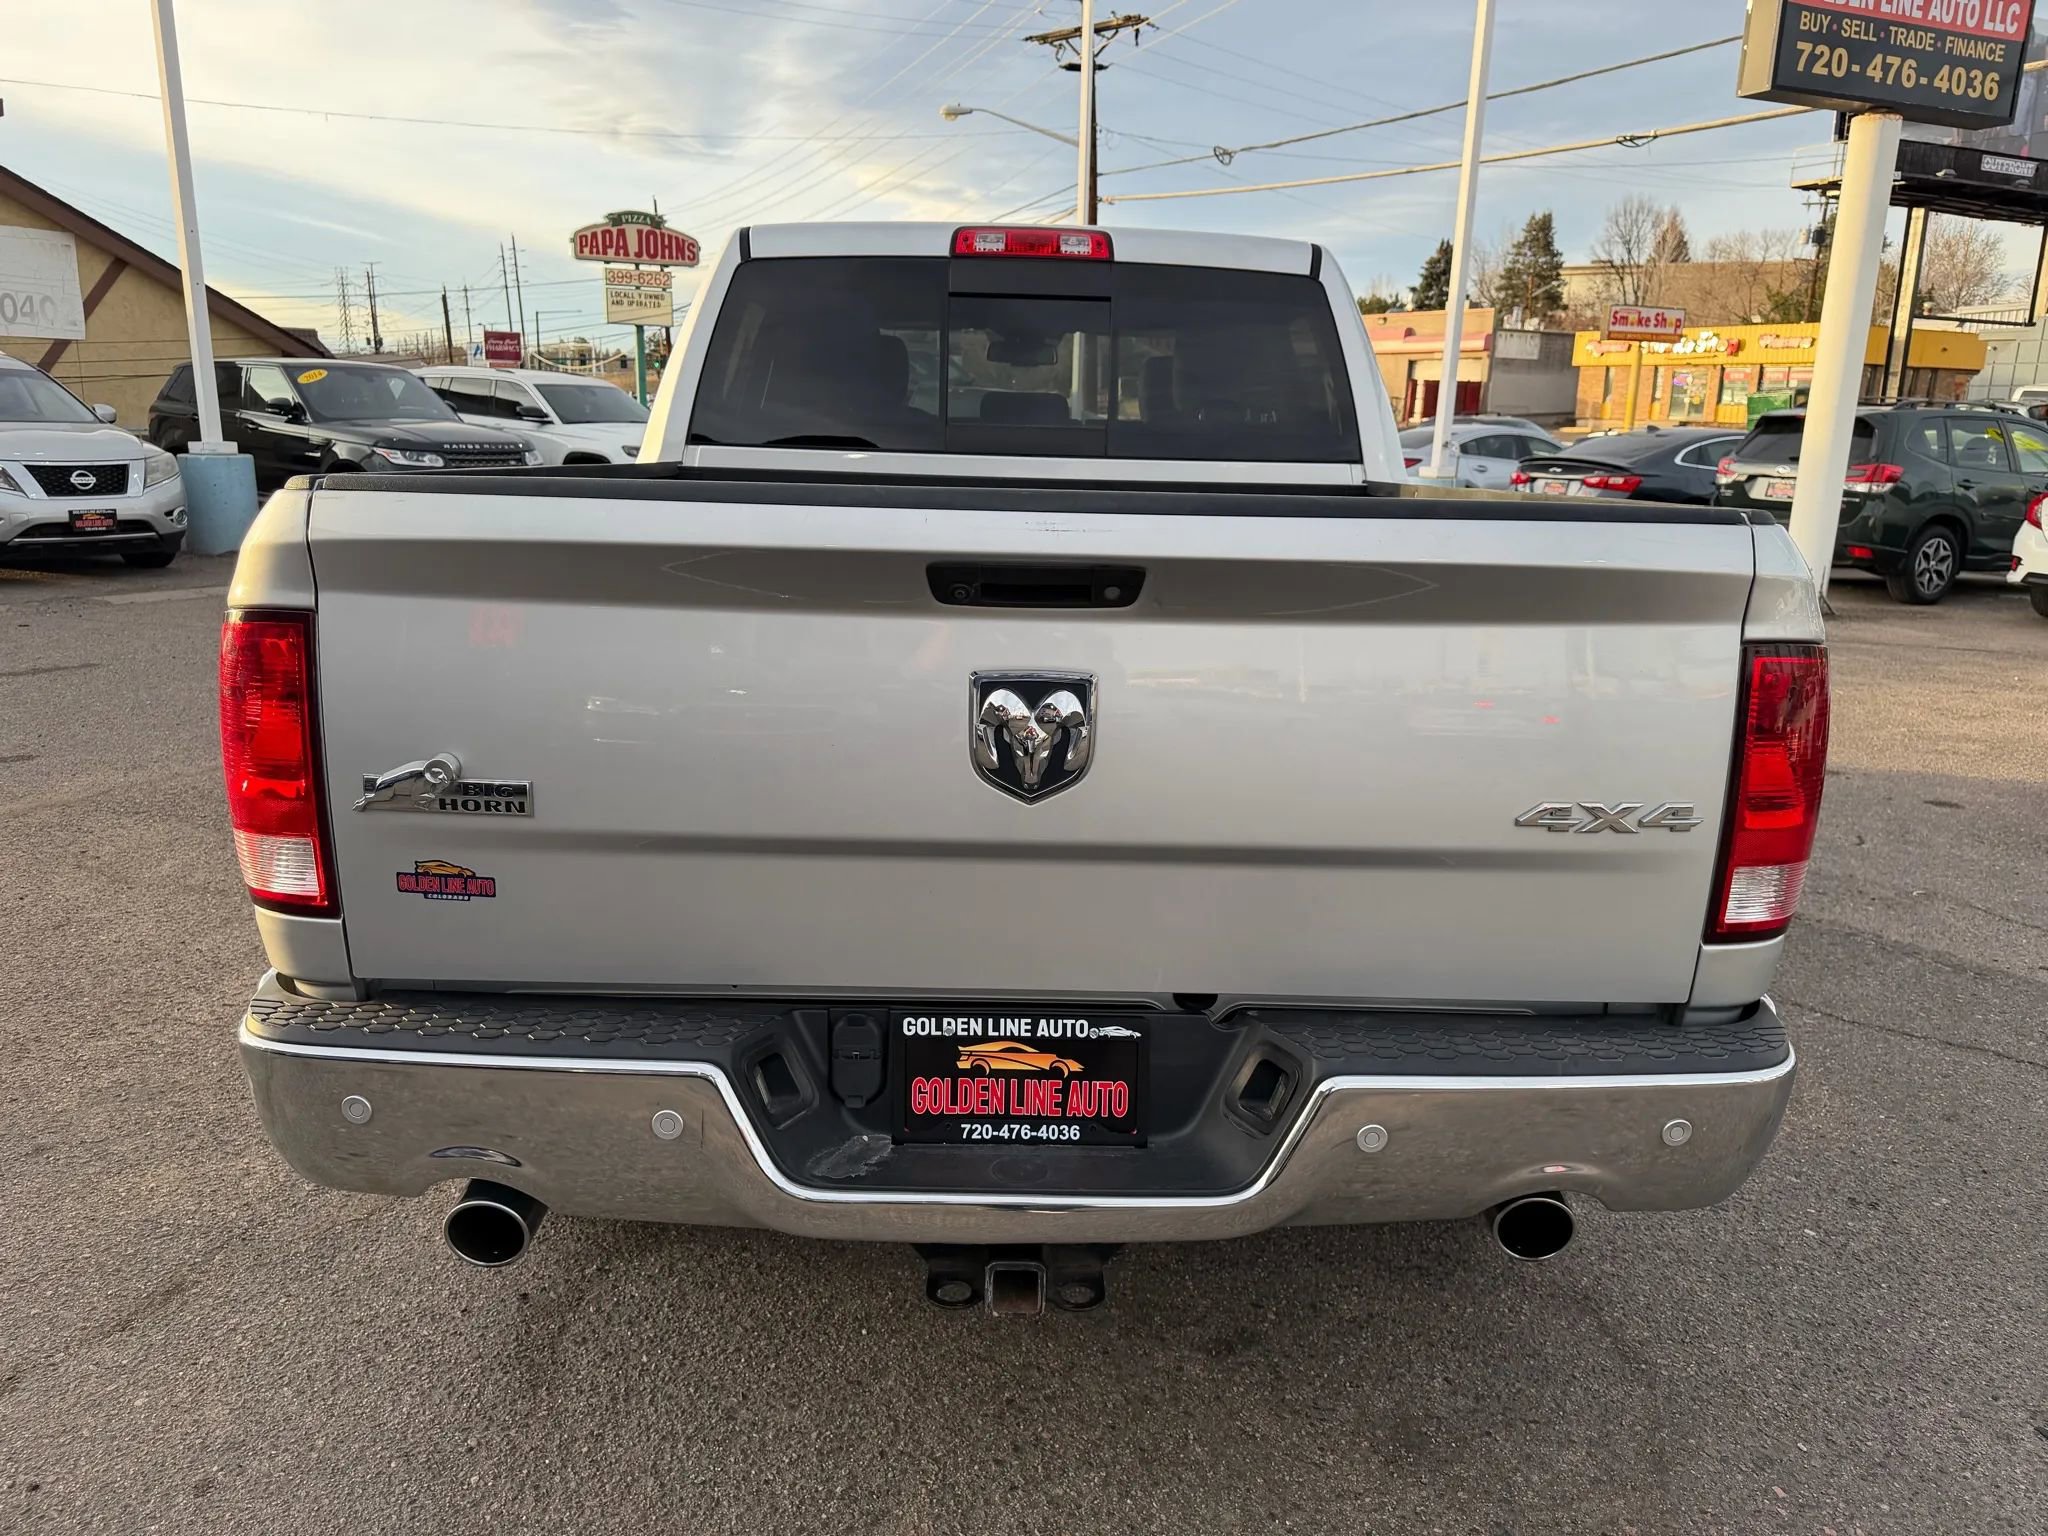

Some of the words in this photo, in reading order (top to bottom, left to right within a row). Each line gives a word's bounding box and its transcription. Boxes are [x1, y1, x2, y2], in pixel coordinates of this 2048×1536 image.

[1927, 0, 1981, 29] AUTO
[1983, 0, 2021, 34] LLC
[1800, 10, 1832, 34] BUY
[1840, 19, 1877, 42] SELL
[1888, 26, 1936, 51] TRADE
[1944, 36, 2006, 62] FINANCE
[1982, 156, 2036, 176] OUTFRONT
[621, 214, 651, 224] PIZZA
[578, 228, 630, 257] PAPA
[607, 270, 670, 286] 399-6262
[461, 783, 513, 797] BIG
[438, 797, 526, 814] HORN
[1514, 801, 1705, 834] 4X4
[398, 874, 440, 892] GOLDEN
[441, 877, 465, 894] LINE
[466, 878, 495, 896] AUTO
[902, 1017, 982, 1036] GOLDEN
[988, 1018, 1032, 1037] LINE
[1036, 1018, 1089, 1038] AUTO
[911, 1077, 1005, 1115] GOLDEN
[1010, 1078, 1062, 1117] LINE
[1066, 1080, 1129, 1118] AUTO
[960, 1123, 1081, 1140] 720-476-4036
